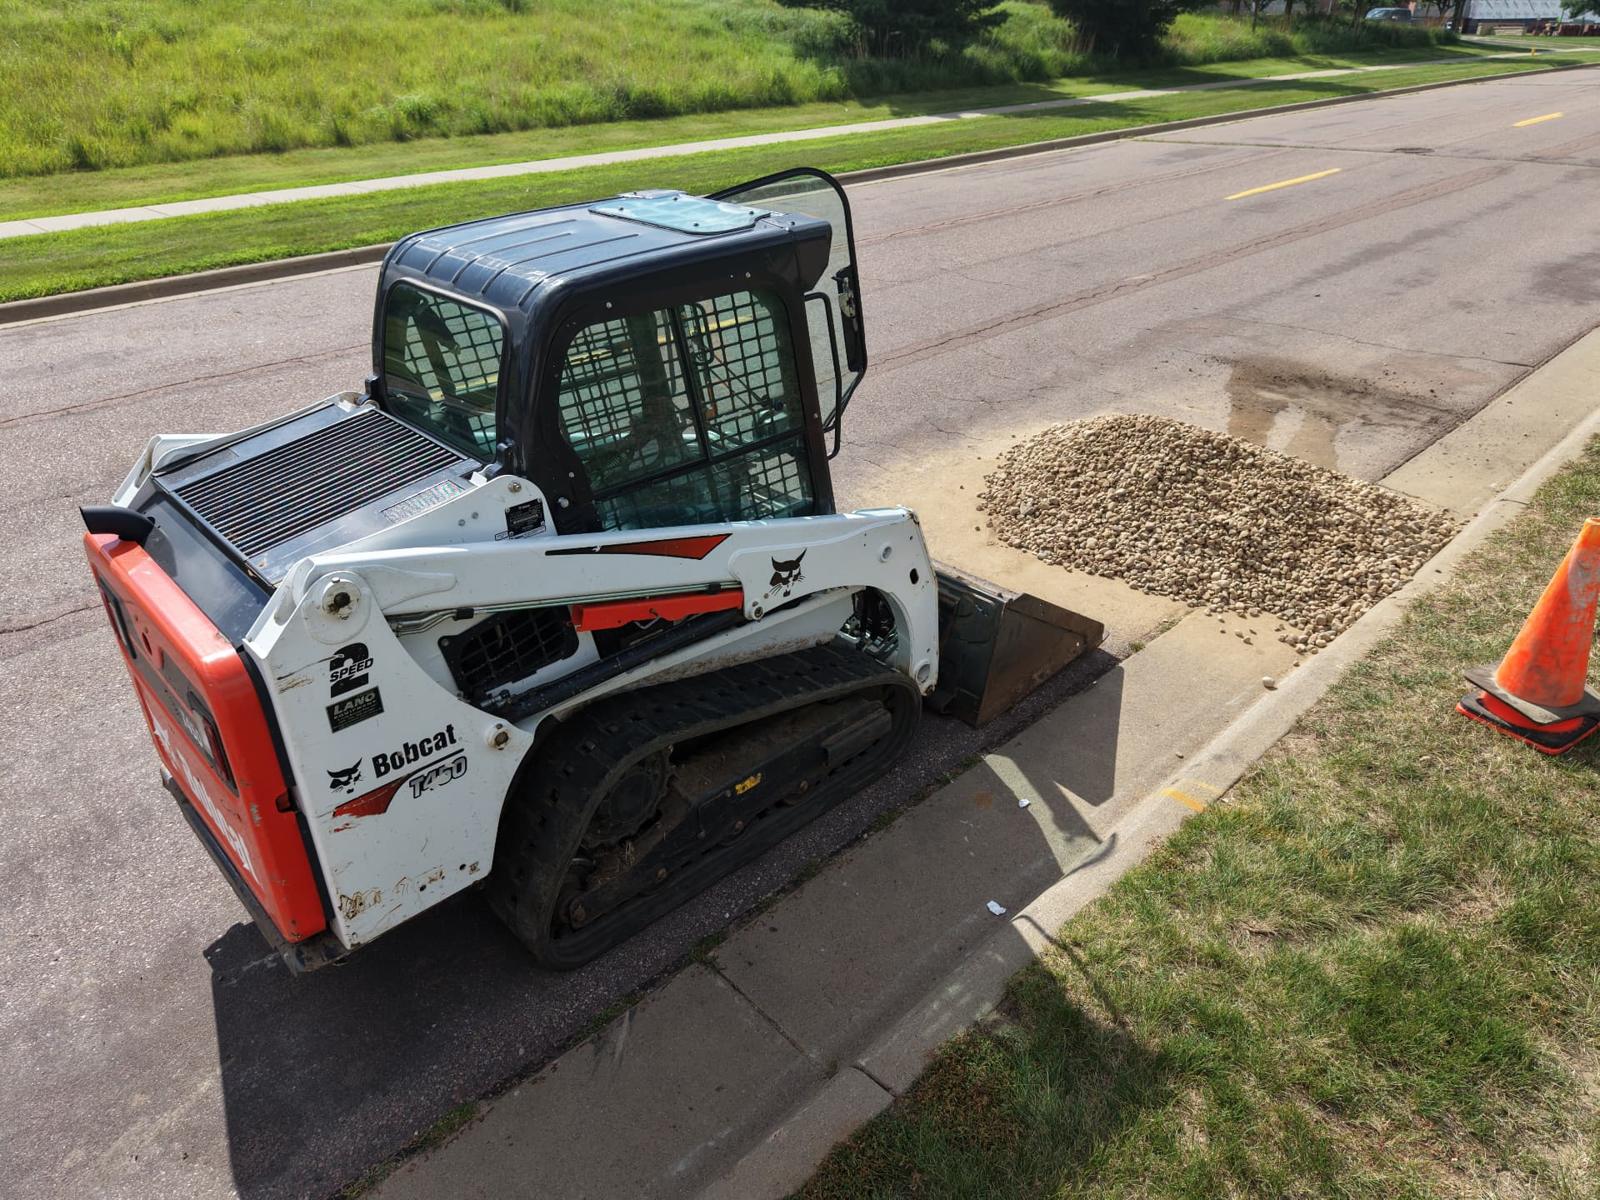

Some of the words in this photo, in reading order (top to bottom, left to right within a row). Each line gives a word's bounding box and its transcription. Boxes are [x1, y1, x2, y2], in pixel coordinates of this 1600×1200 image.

[329, 642, 369, 698] 2
[330, 658, 374, 682] SPEED
[334, 692, 376, 715] LANO
[372, 724, 457, 778] Bobcat
[409, 755, 467, 799] T450
